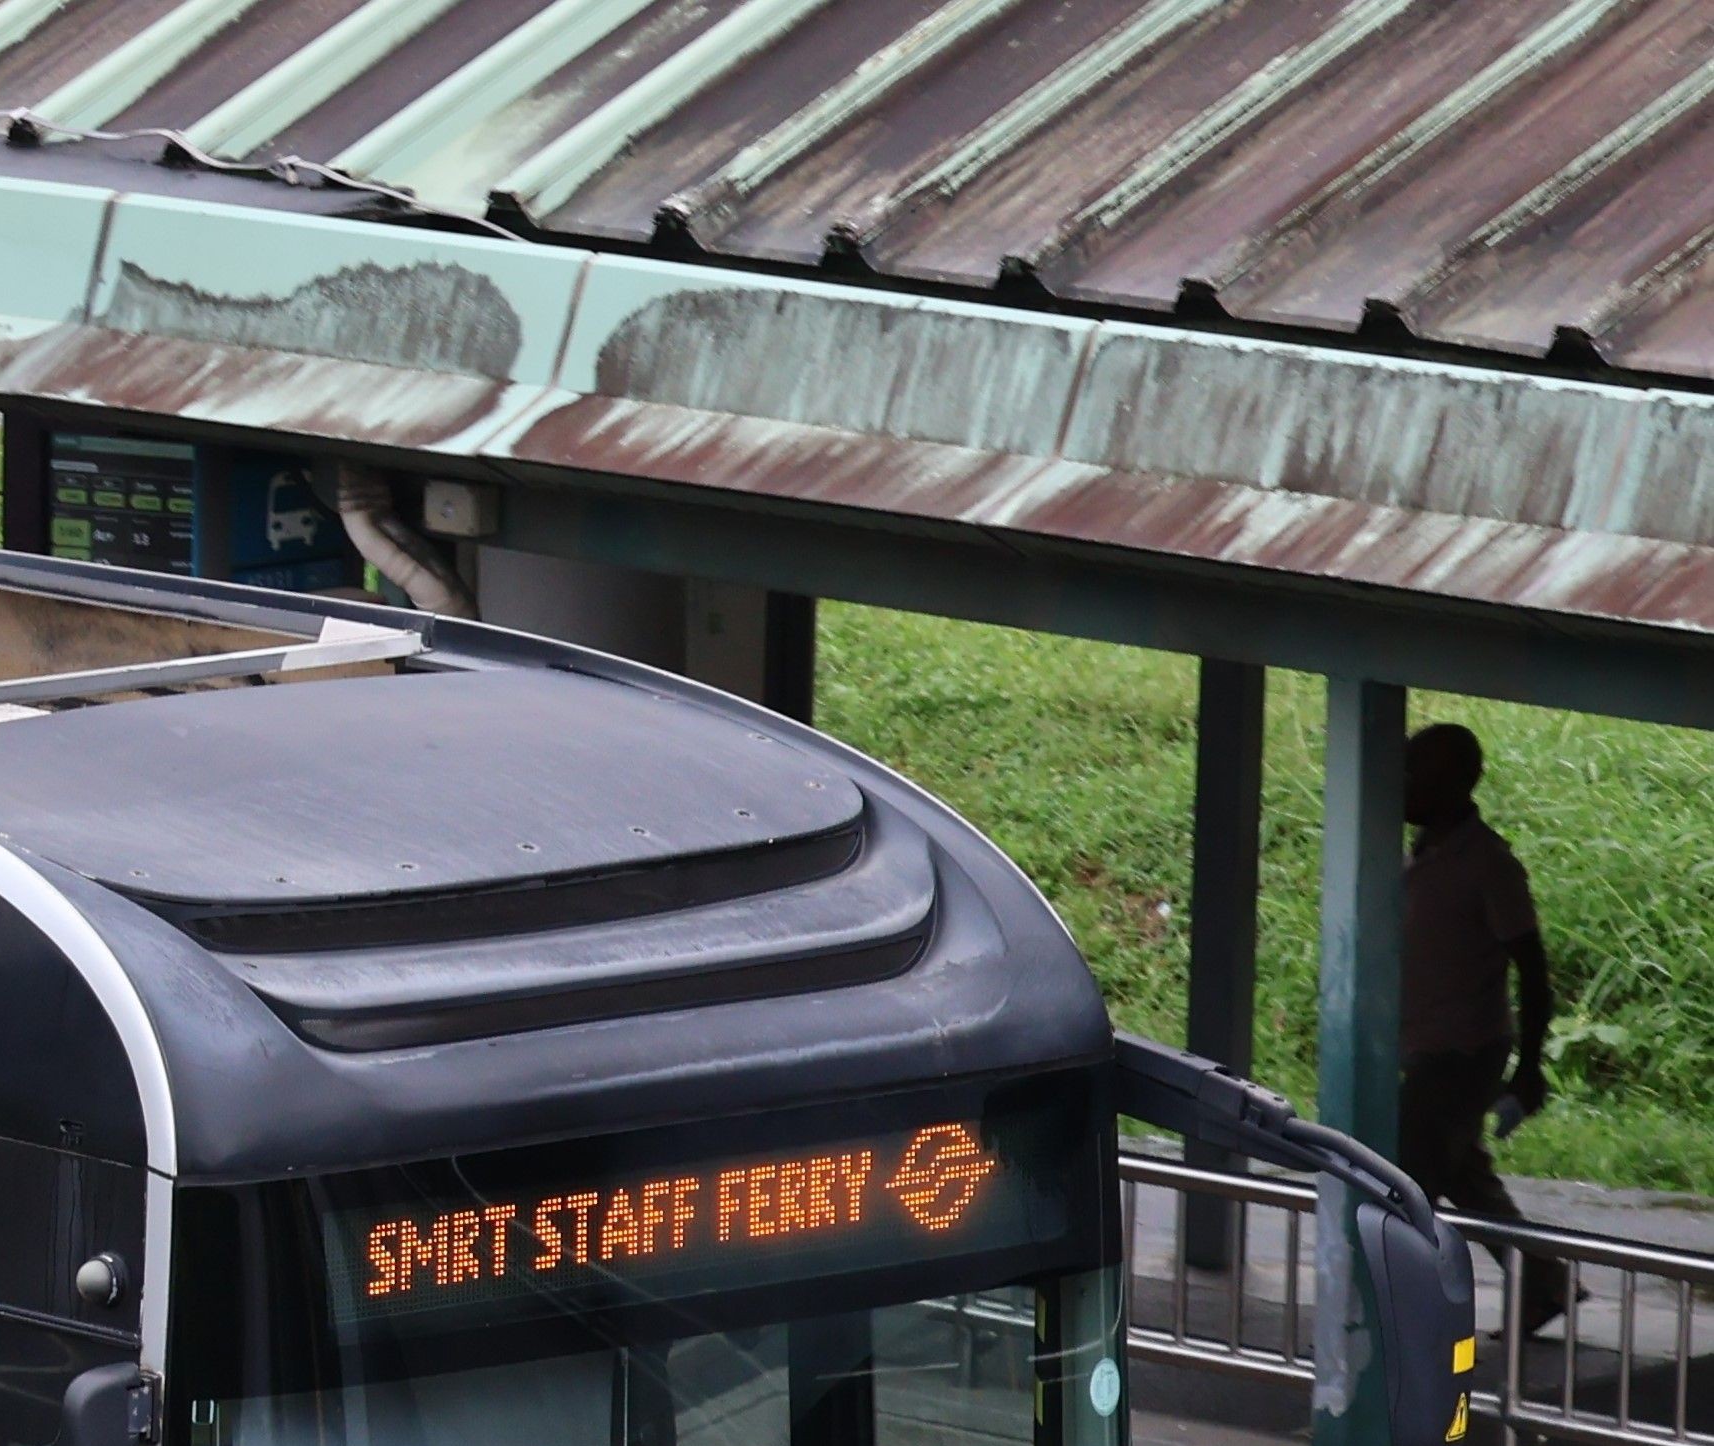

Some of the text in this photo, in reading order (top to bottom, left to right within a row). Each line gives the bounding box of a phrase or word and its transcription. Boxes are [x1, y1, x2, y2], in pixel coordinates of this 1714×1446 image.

[368, 1151, 873, 1297] SMRT STAFF FERRY
